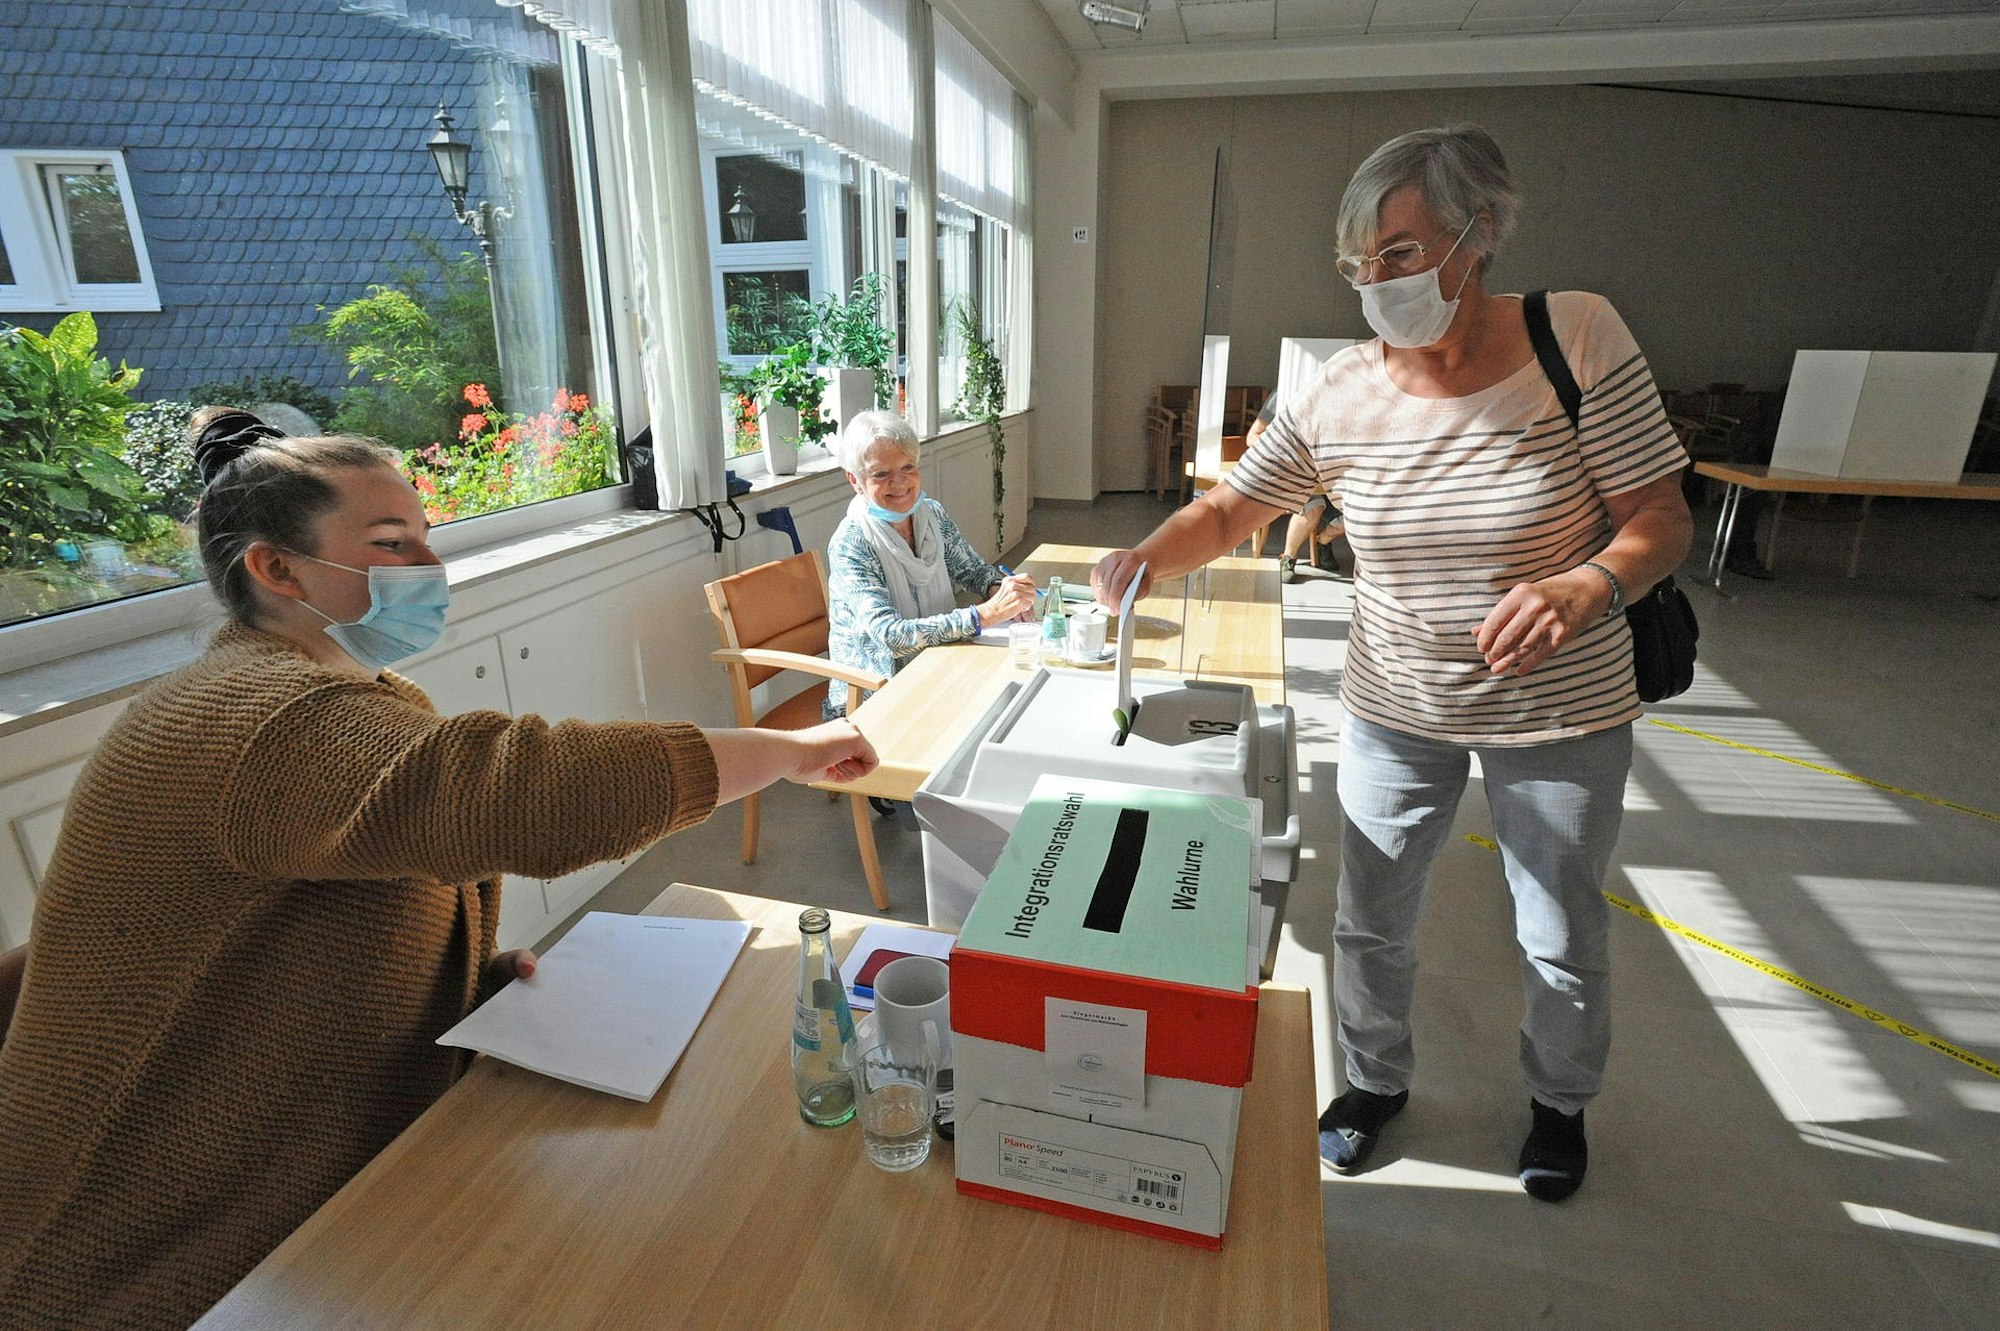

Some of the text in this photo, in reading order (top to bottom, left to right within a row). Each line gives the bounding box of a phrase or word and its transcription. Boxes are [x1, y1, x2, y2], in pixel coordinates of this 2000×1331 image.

[1005, 792, 1085, 938] Integrationsratswahl
[1171, 840, 1204, 910] Wahlurne
[1684, 932, 1724, 951] ABSTAND
[1787, 977, 1822, 996] HALTEN
[1824, 994, 1853, 1009] BITTE
[1929, 1040, 1983, 1067] ABSTAND
